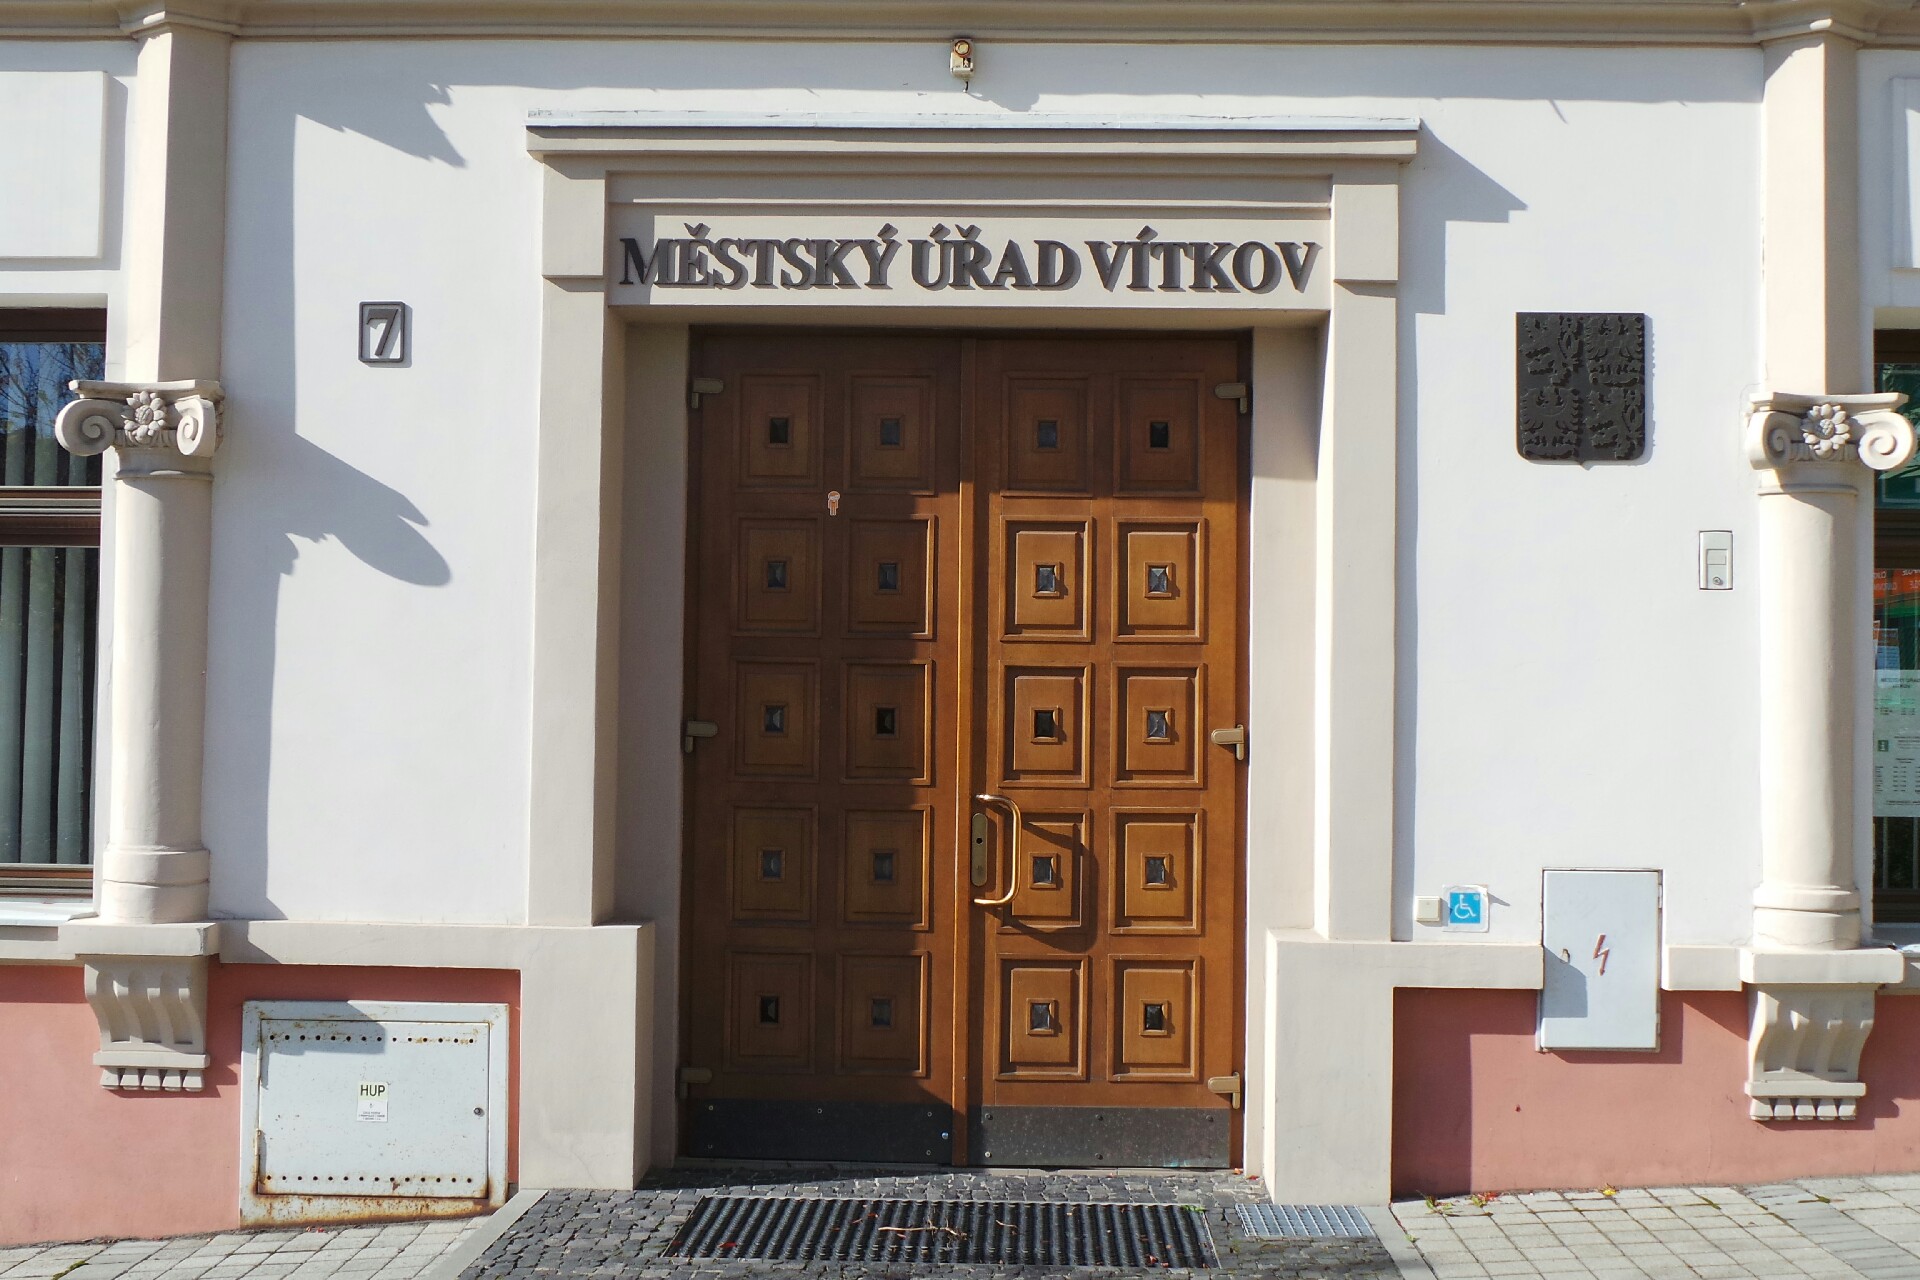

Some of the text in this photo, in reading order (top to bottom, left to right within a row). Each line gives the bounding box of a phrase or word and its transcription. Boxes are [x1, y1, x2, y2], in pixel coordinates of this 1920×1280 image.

[619, 223, 1322, 292] MĚSTSKÝ ÚŘAD VÍTKOV
[366, 308, 399, 357] 7
[360, 1084, 386, 1097] HUP
